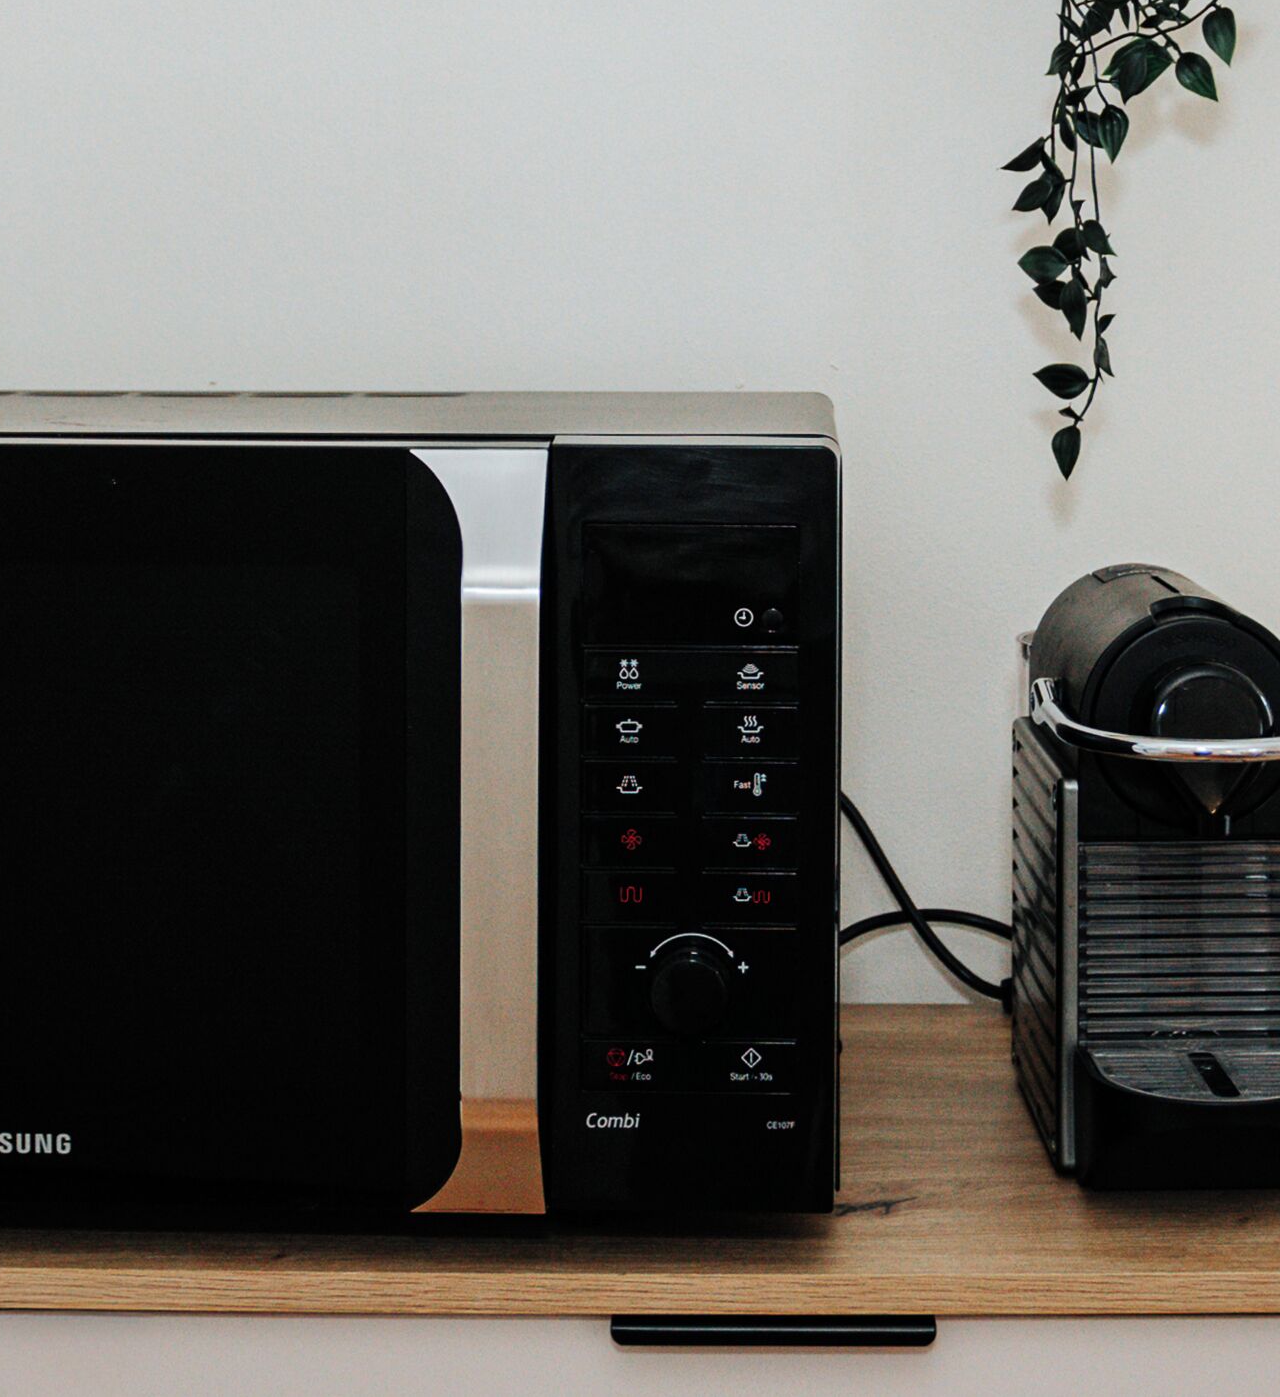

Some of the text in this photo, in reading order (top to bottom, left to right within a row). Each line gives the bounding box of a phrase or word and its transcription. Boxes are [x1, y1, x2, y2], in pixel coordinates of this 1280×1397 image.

[616, 680, 642, 691] Power
[736, 680, 765, 691] Sensor
[619, 734, 639, 744] Auto
[740, 734, 761, 744] Auto
[733, 779, 751, 790] Fast
[585, 1112, 641, 1129] Combi
